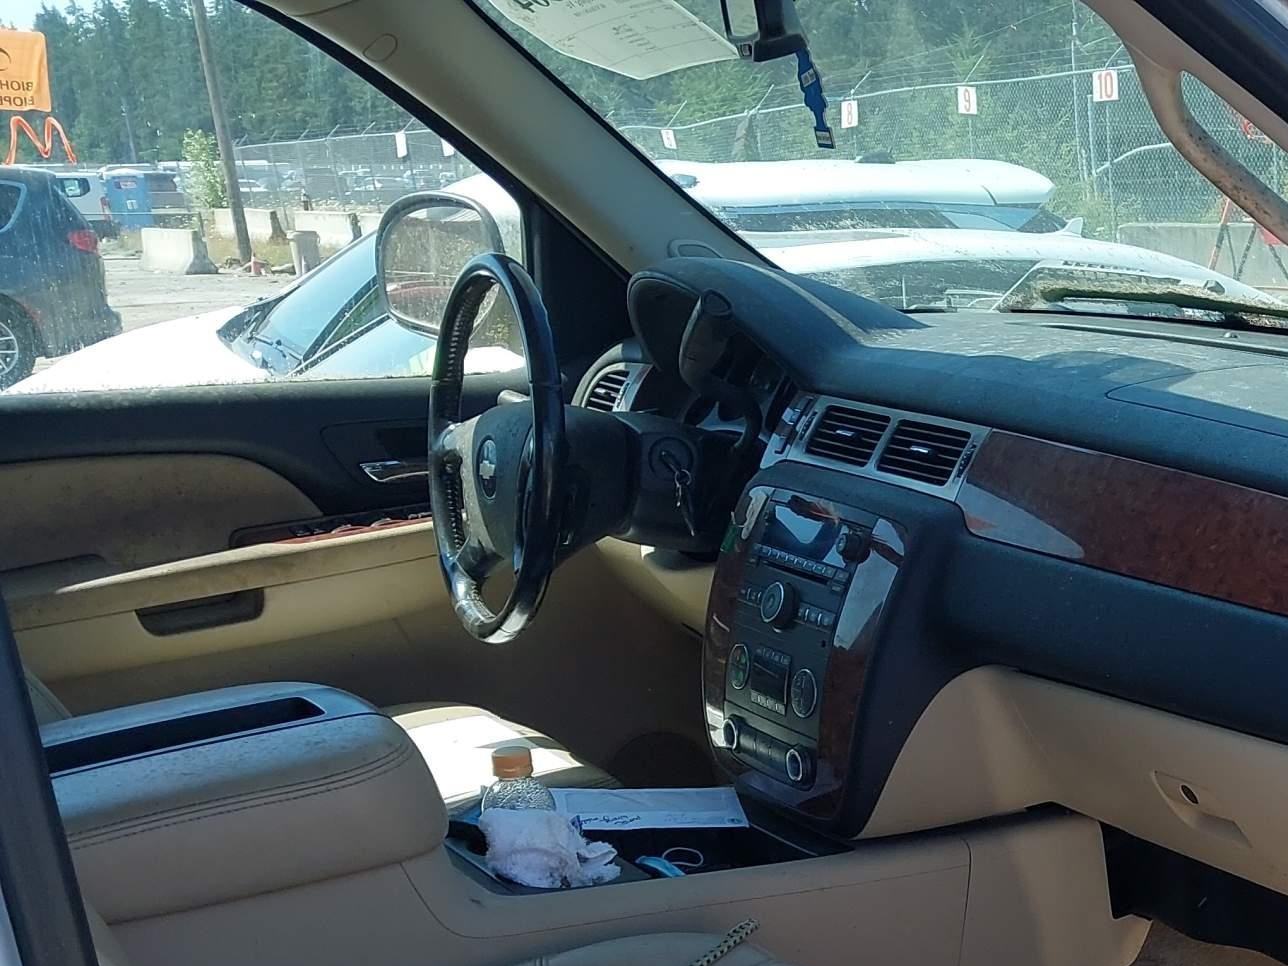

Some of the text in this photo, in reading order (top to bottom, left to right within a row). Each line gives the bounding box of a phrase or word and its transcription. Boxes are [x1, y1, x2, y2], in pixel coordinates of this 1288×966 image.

[1096, 71, 1114, 99] 10
[963, 88, 971, 112] 9
[845, 102, 854, 126] 8
